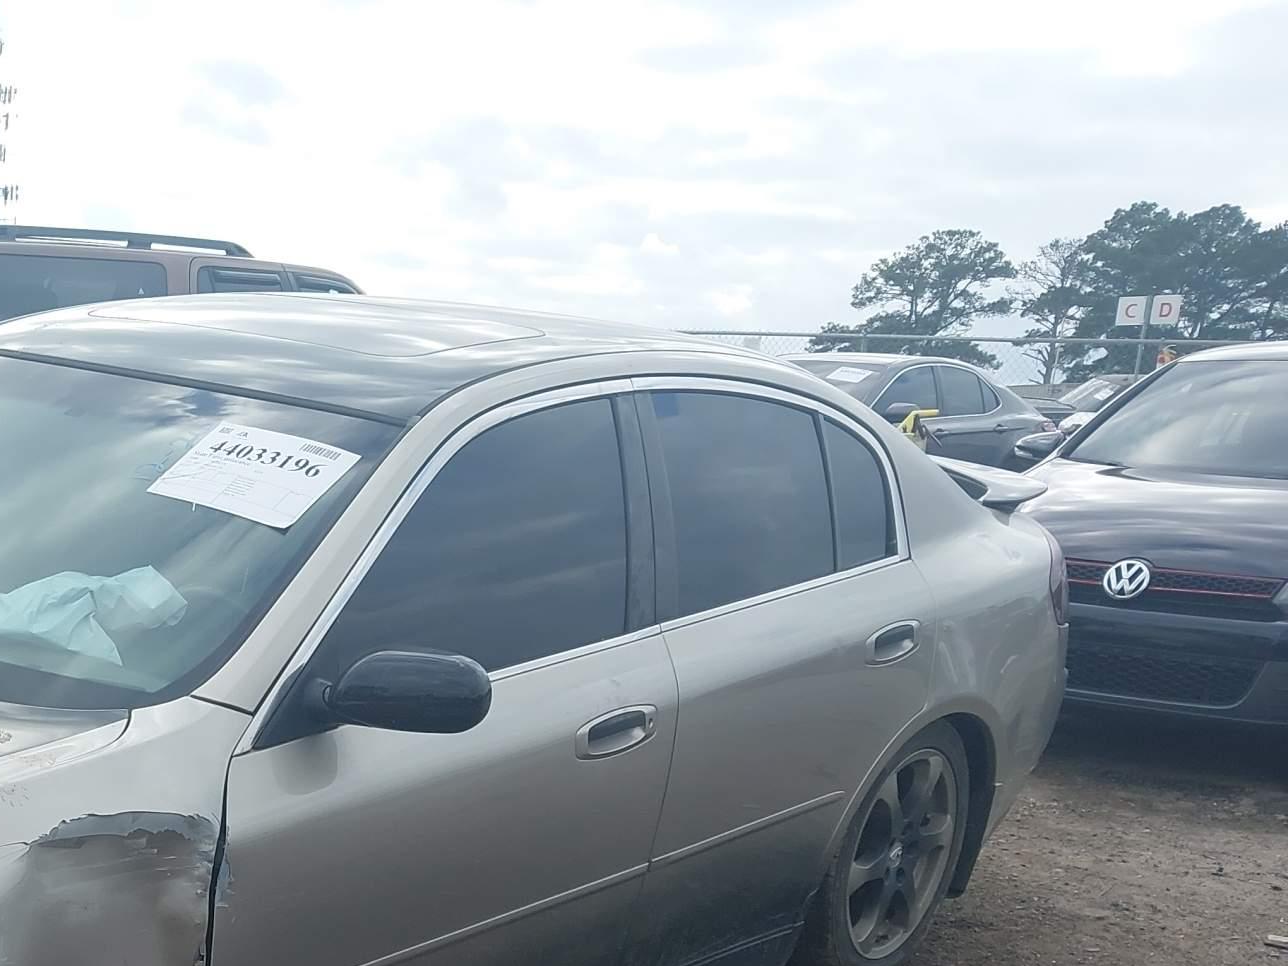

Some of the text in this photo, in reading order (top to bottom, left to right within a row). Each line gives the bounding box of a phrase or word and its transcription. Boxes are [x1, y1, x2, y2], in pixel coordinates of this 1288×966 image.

[1125, 304, 1138, 318] C
[1160, 303, 1172, 317] D
[209, 440, 329, 478] 44033196
[1106, 561, 1148, 597] VW
